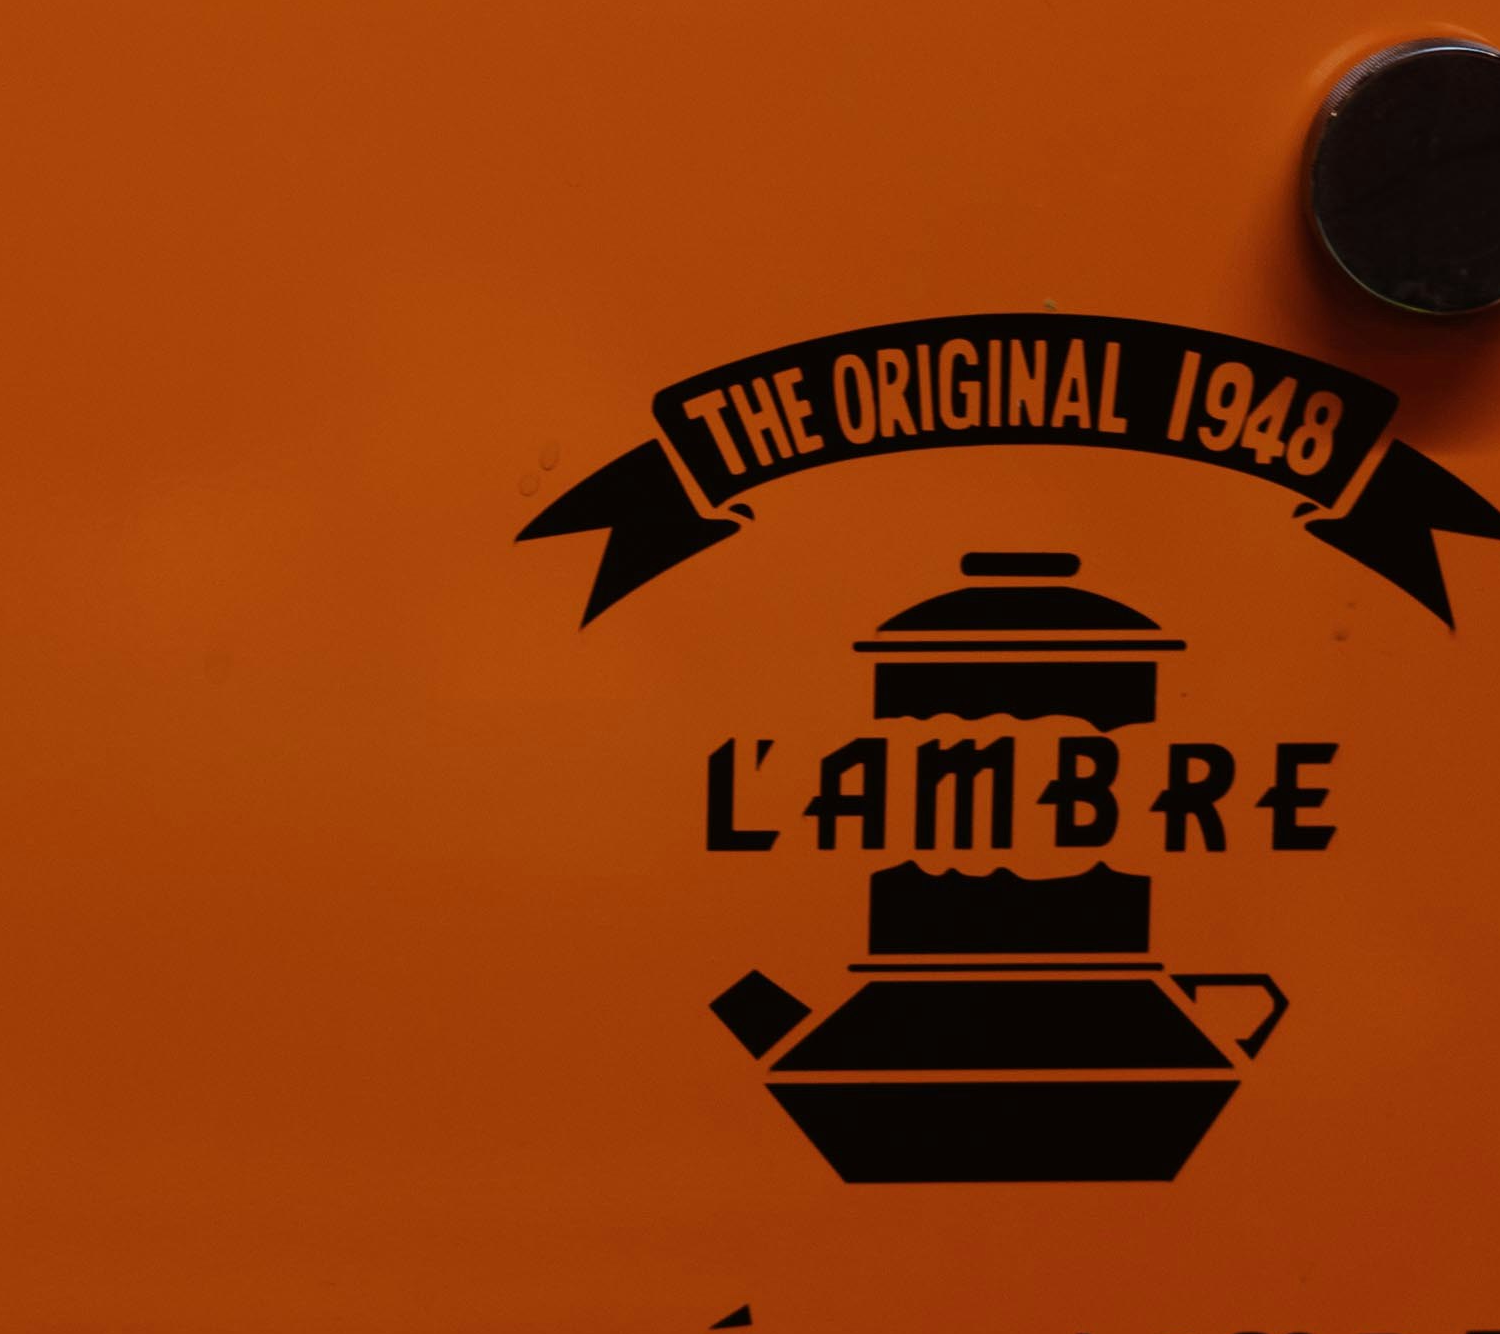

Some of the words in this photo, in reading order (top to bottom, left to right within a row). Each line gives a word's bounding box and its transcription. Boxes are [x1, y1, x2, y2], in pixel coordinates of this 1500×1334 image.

[682, 367, 824, 476] THE
[833, 338, 1128, 445] ORIGINAL
[1166, 349, 1343, 476] 1948
[706, 735, 1340, 852] L'AMBRE
